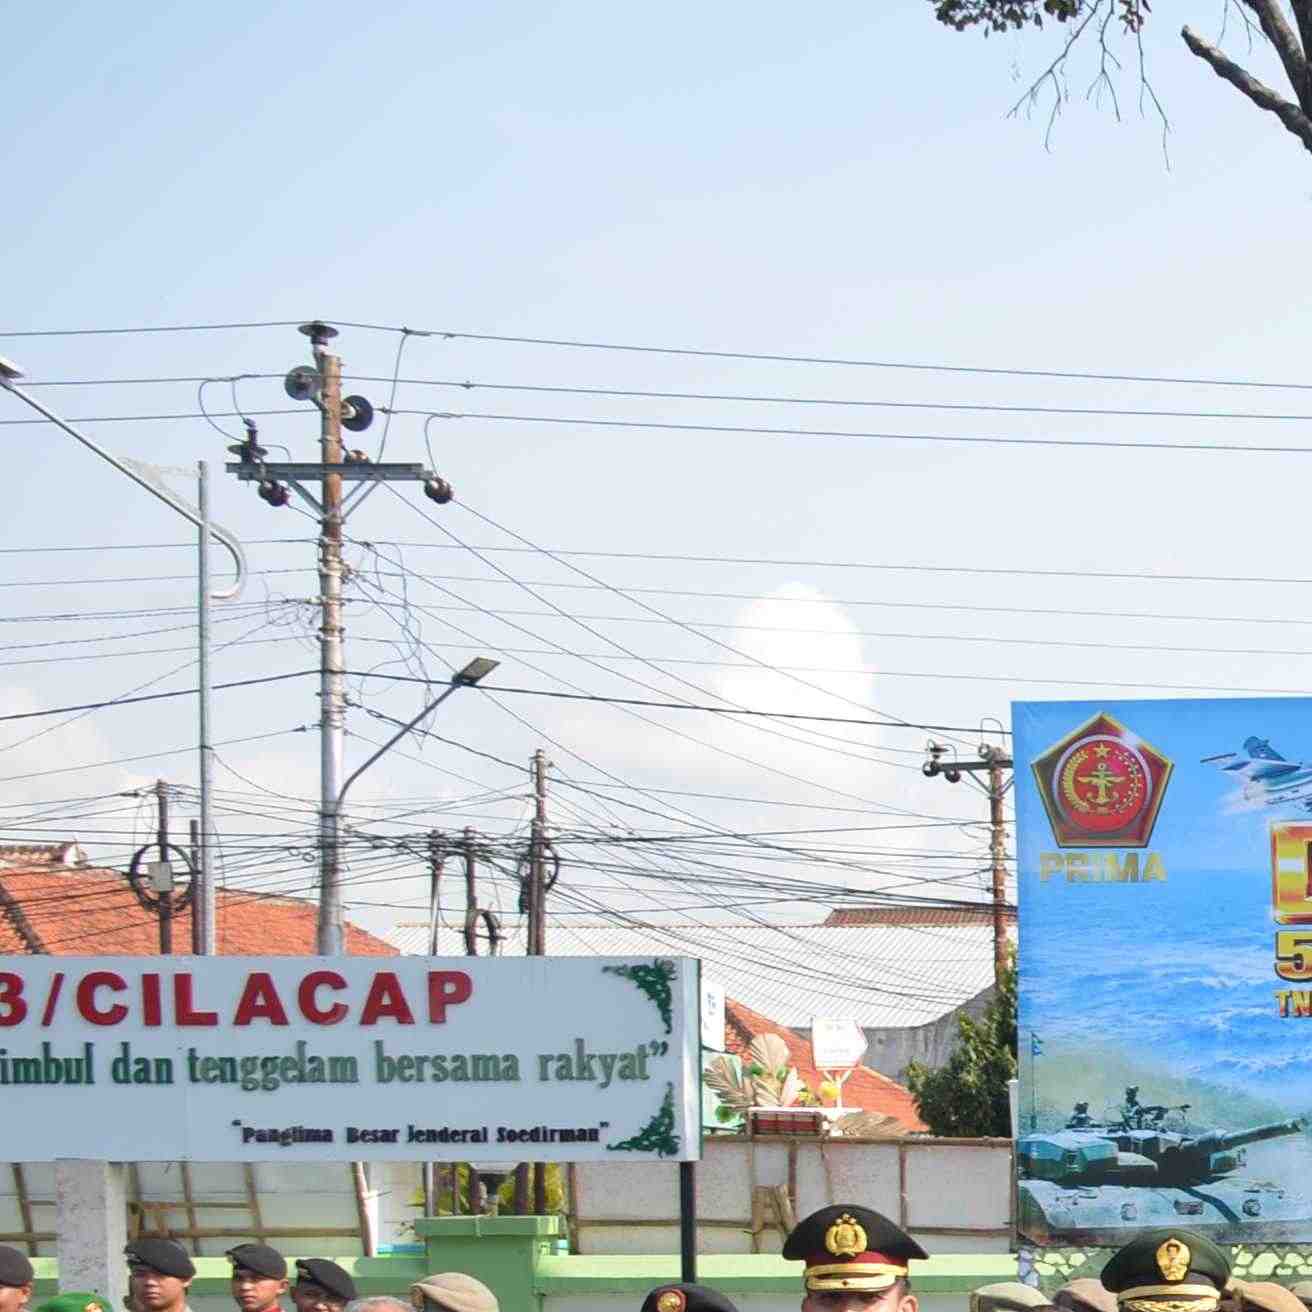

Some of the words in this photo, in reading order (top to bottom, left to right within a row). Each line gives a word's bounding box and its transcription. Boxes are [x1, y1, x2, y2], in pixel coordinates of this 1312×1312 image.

[1040, 852, 1168, 883] PRIMA
[0, 1040, 94, 1085] imbul
[111, 1040, 174, 1084] dan
[187, 1040, 360, 1092] tenggelam
[373, 1039, 521, 1083] bersama
[345, 1126, 401, 1144] Besar
[406, 1123, 489, 1144] Jenderal
